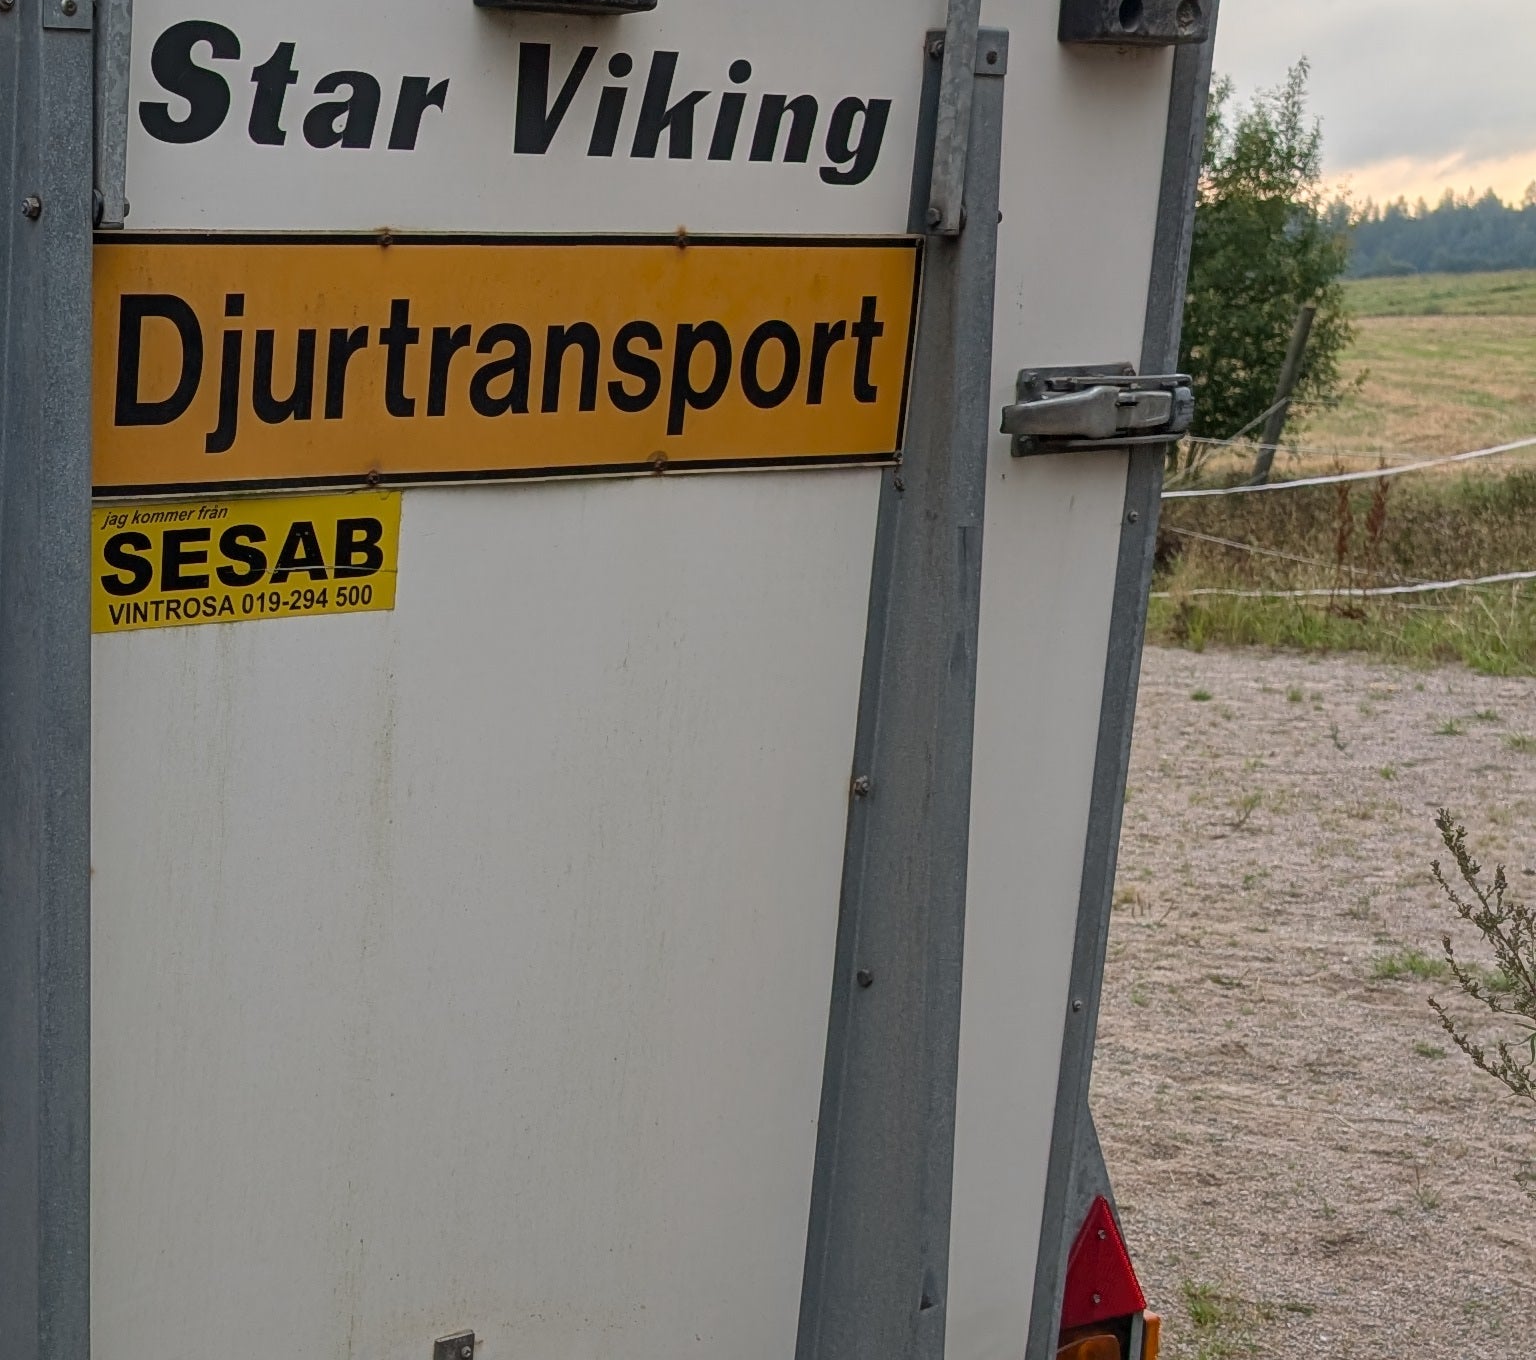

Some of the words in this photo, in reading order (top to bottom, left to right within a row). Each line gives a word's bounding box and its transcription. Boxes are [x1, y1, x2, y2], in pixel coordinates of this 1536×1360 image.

[138, 19, 450, 151] Star
[513, 41, 893, 186] Viking
[113, 293, 886, 455] Djurtransport
[100, 511, 129, 530] jag
[130, 510, 196, 525] kommer
[197, 504, 228, 520] från
[100, 517, 385, 597] SESAB
[108, 594, 235, 626] VINTROSA
[241, 587, 329, 615] 019-294
[335, 584, 373, 609] 500
